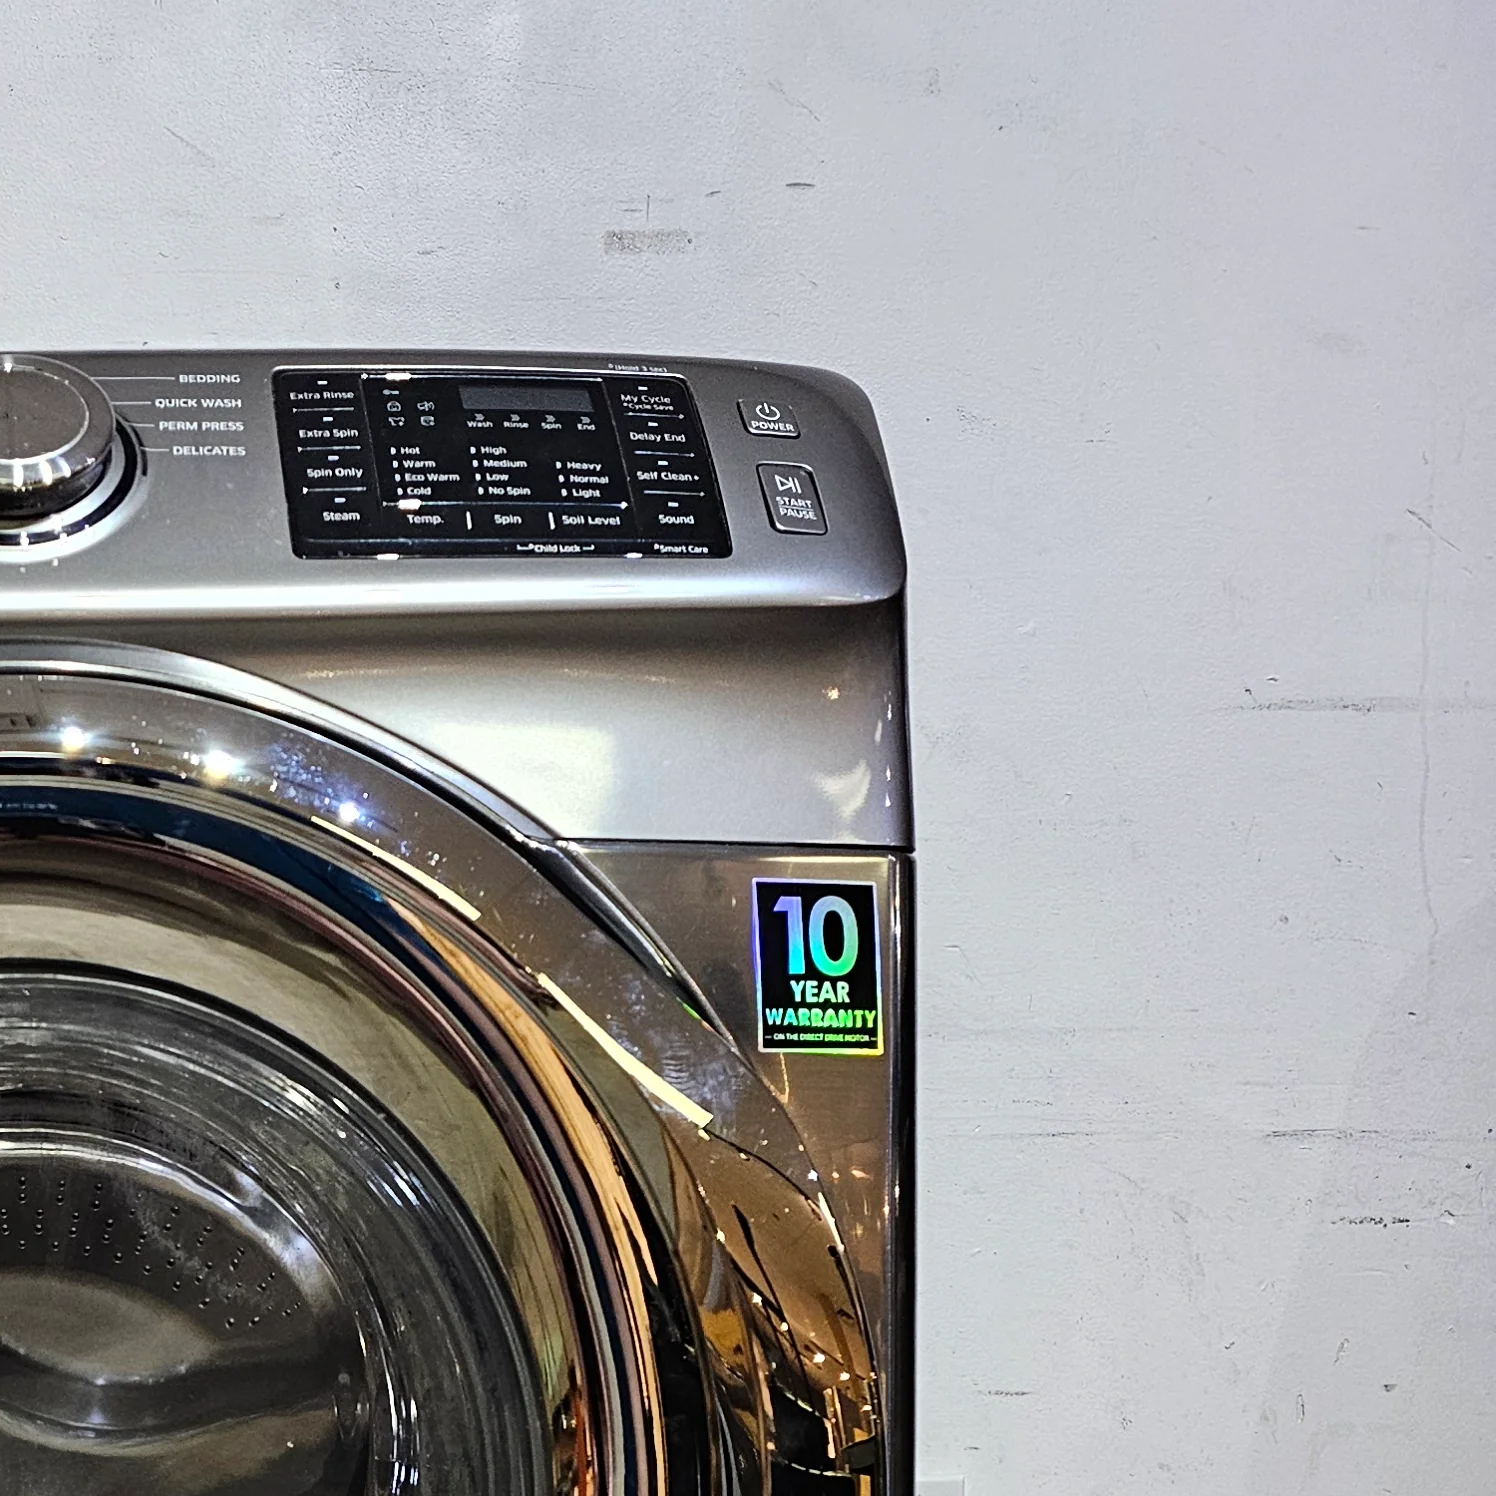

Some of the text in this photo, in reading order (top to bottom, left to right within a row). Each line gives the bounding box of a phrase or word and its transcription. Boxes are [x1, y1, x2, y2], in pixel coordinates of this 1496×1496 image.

[179, 374, 241, 383] BEDDING
[290, 390, 354, 400] Extra Rinse
[621, 394, 671, 404] My Cycle
[155, 399, 242, 409] QUICK WASH
[159, 421, 244, 431] PERM PRESS
[467, 420, 493, 429] Wash
[504, 421, 529, 429] Rinse
[541, 421, 562, 430] Spin
[577, 423, 595, 431] End
[751, 420, 795, 432] POWER
[298, 428, 359, 439] Extra Spin
[629, 432, 686, 443] Delay End
[173, 446, 246, 456] DELICATES
[400, 446, 420, 455] Hot
[480, 446, 507, 456] High
[402, 460, 436, 468] Warm
[483, 459, 527, 468] Medium
[567, 461, 602, 471] Heavy
[306, 468, 363, 479] Spin Only
[404, 473, 460, 482] Eco Warm
[485, 473, 509, 482] Low
[636, 471, 659, 481] Self
[570, 475, 609, 484] Normal
[407, 486, 431, 496] Cold
[488, 486, 531, 497] No Spin
[572, 488, 601, 498] Light
[776, 497, 812, 508] START
[322, 511, 360, 521] Steam
[779, 508, 817, 520] PAUSE
[407, 514, 444, 525] Temp.
[494, 514, 522, 525] Spin
[561, 515, 621, 526] Soil Level
[658, 515, 695, 525] Sound
[534, 544, 557, 552] Child
[773, 895, 859, 977] 10
[790, 980, 850, 1003] YEAR
[765, 1008, 876, 1028] WARRANTY
